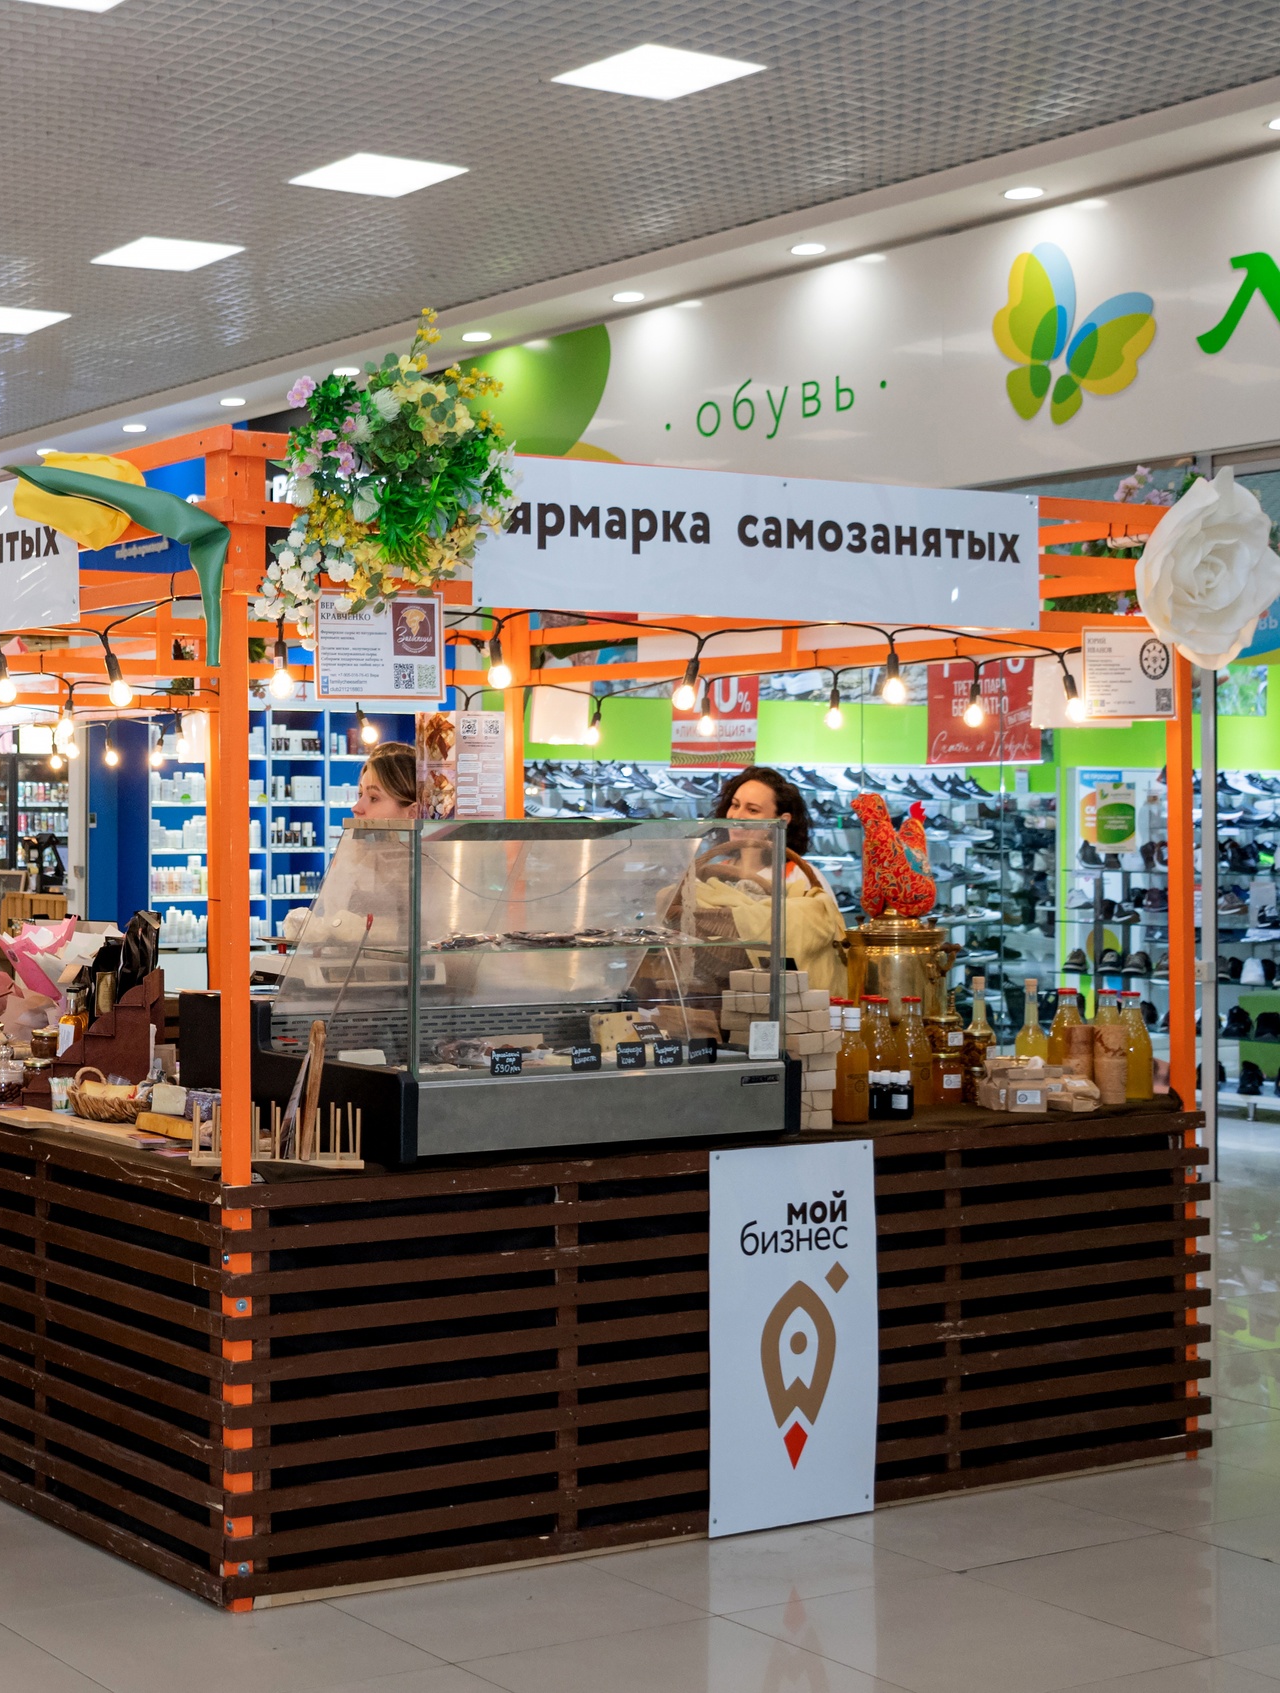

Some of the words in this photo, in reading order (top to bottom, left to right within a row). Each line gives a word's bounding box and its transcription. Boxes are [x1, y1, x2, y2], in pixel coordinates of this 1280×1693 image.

[696, 375, 855, 439] обувь
[506, 502, 710, 554] ярмарка
[737, 514, 1020, 563] самозанятых
[787, 1190, 847, 1225] мой
[740, 1220, 848, 1256] бизнес
